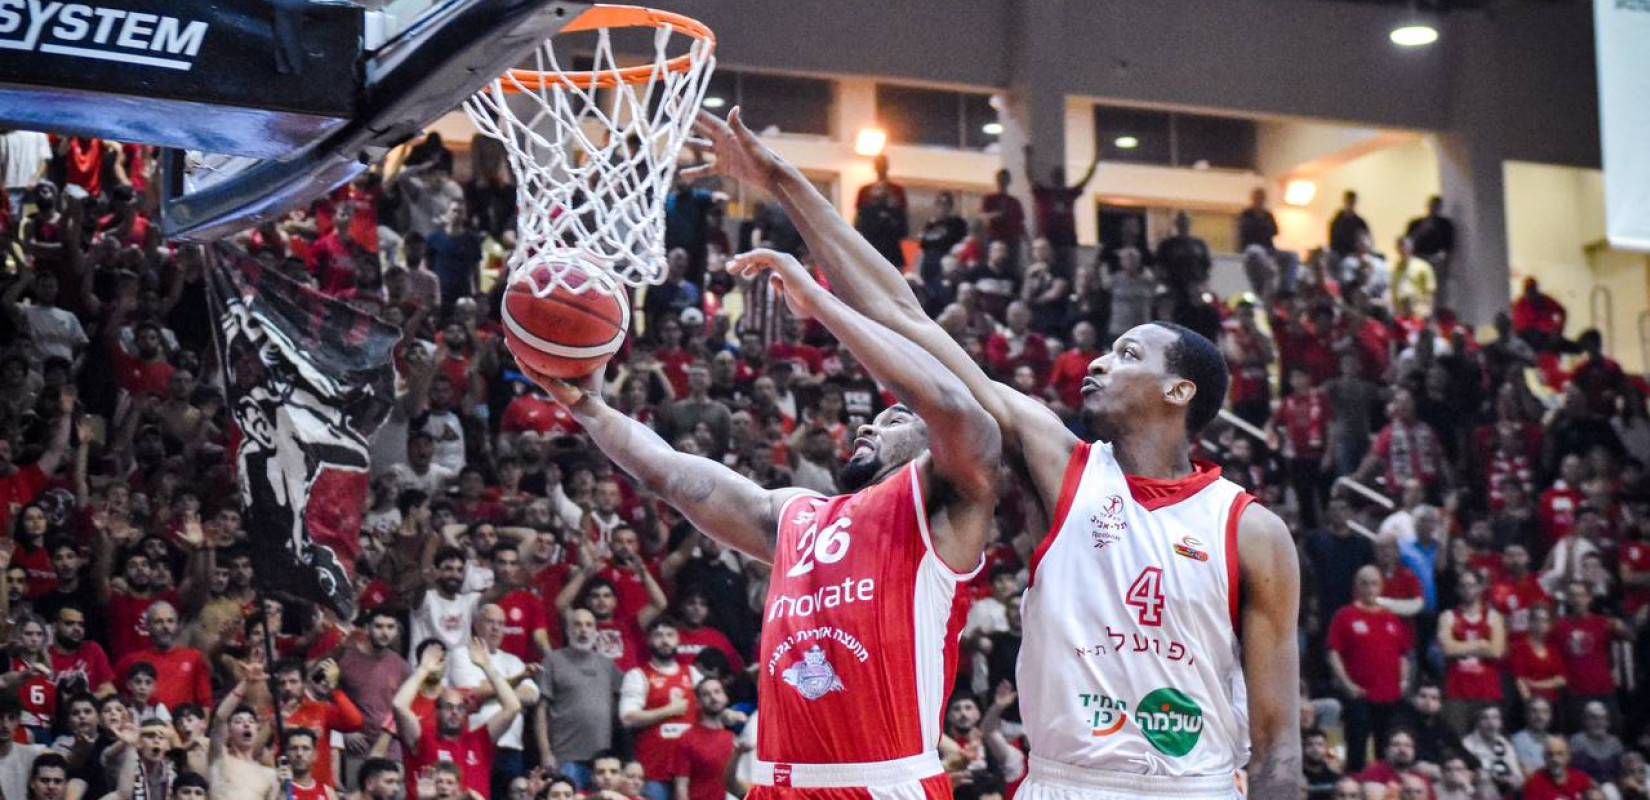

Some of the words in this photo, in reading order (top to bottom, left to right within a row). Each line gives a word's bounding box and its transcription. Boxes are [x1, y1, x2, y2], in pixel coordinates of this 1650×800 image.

[786, 516, 853, 577] 26
[1125, 566, 1165, 627] 4
[1105, 626, 1194, 665] פועל
[30, 684, 45, 705] 6
[1137, 711, 1202, 733] שלמה
